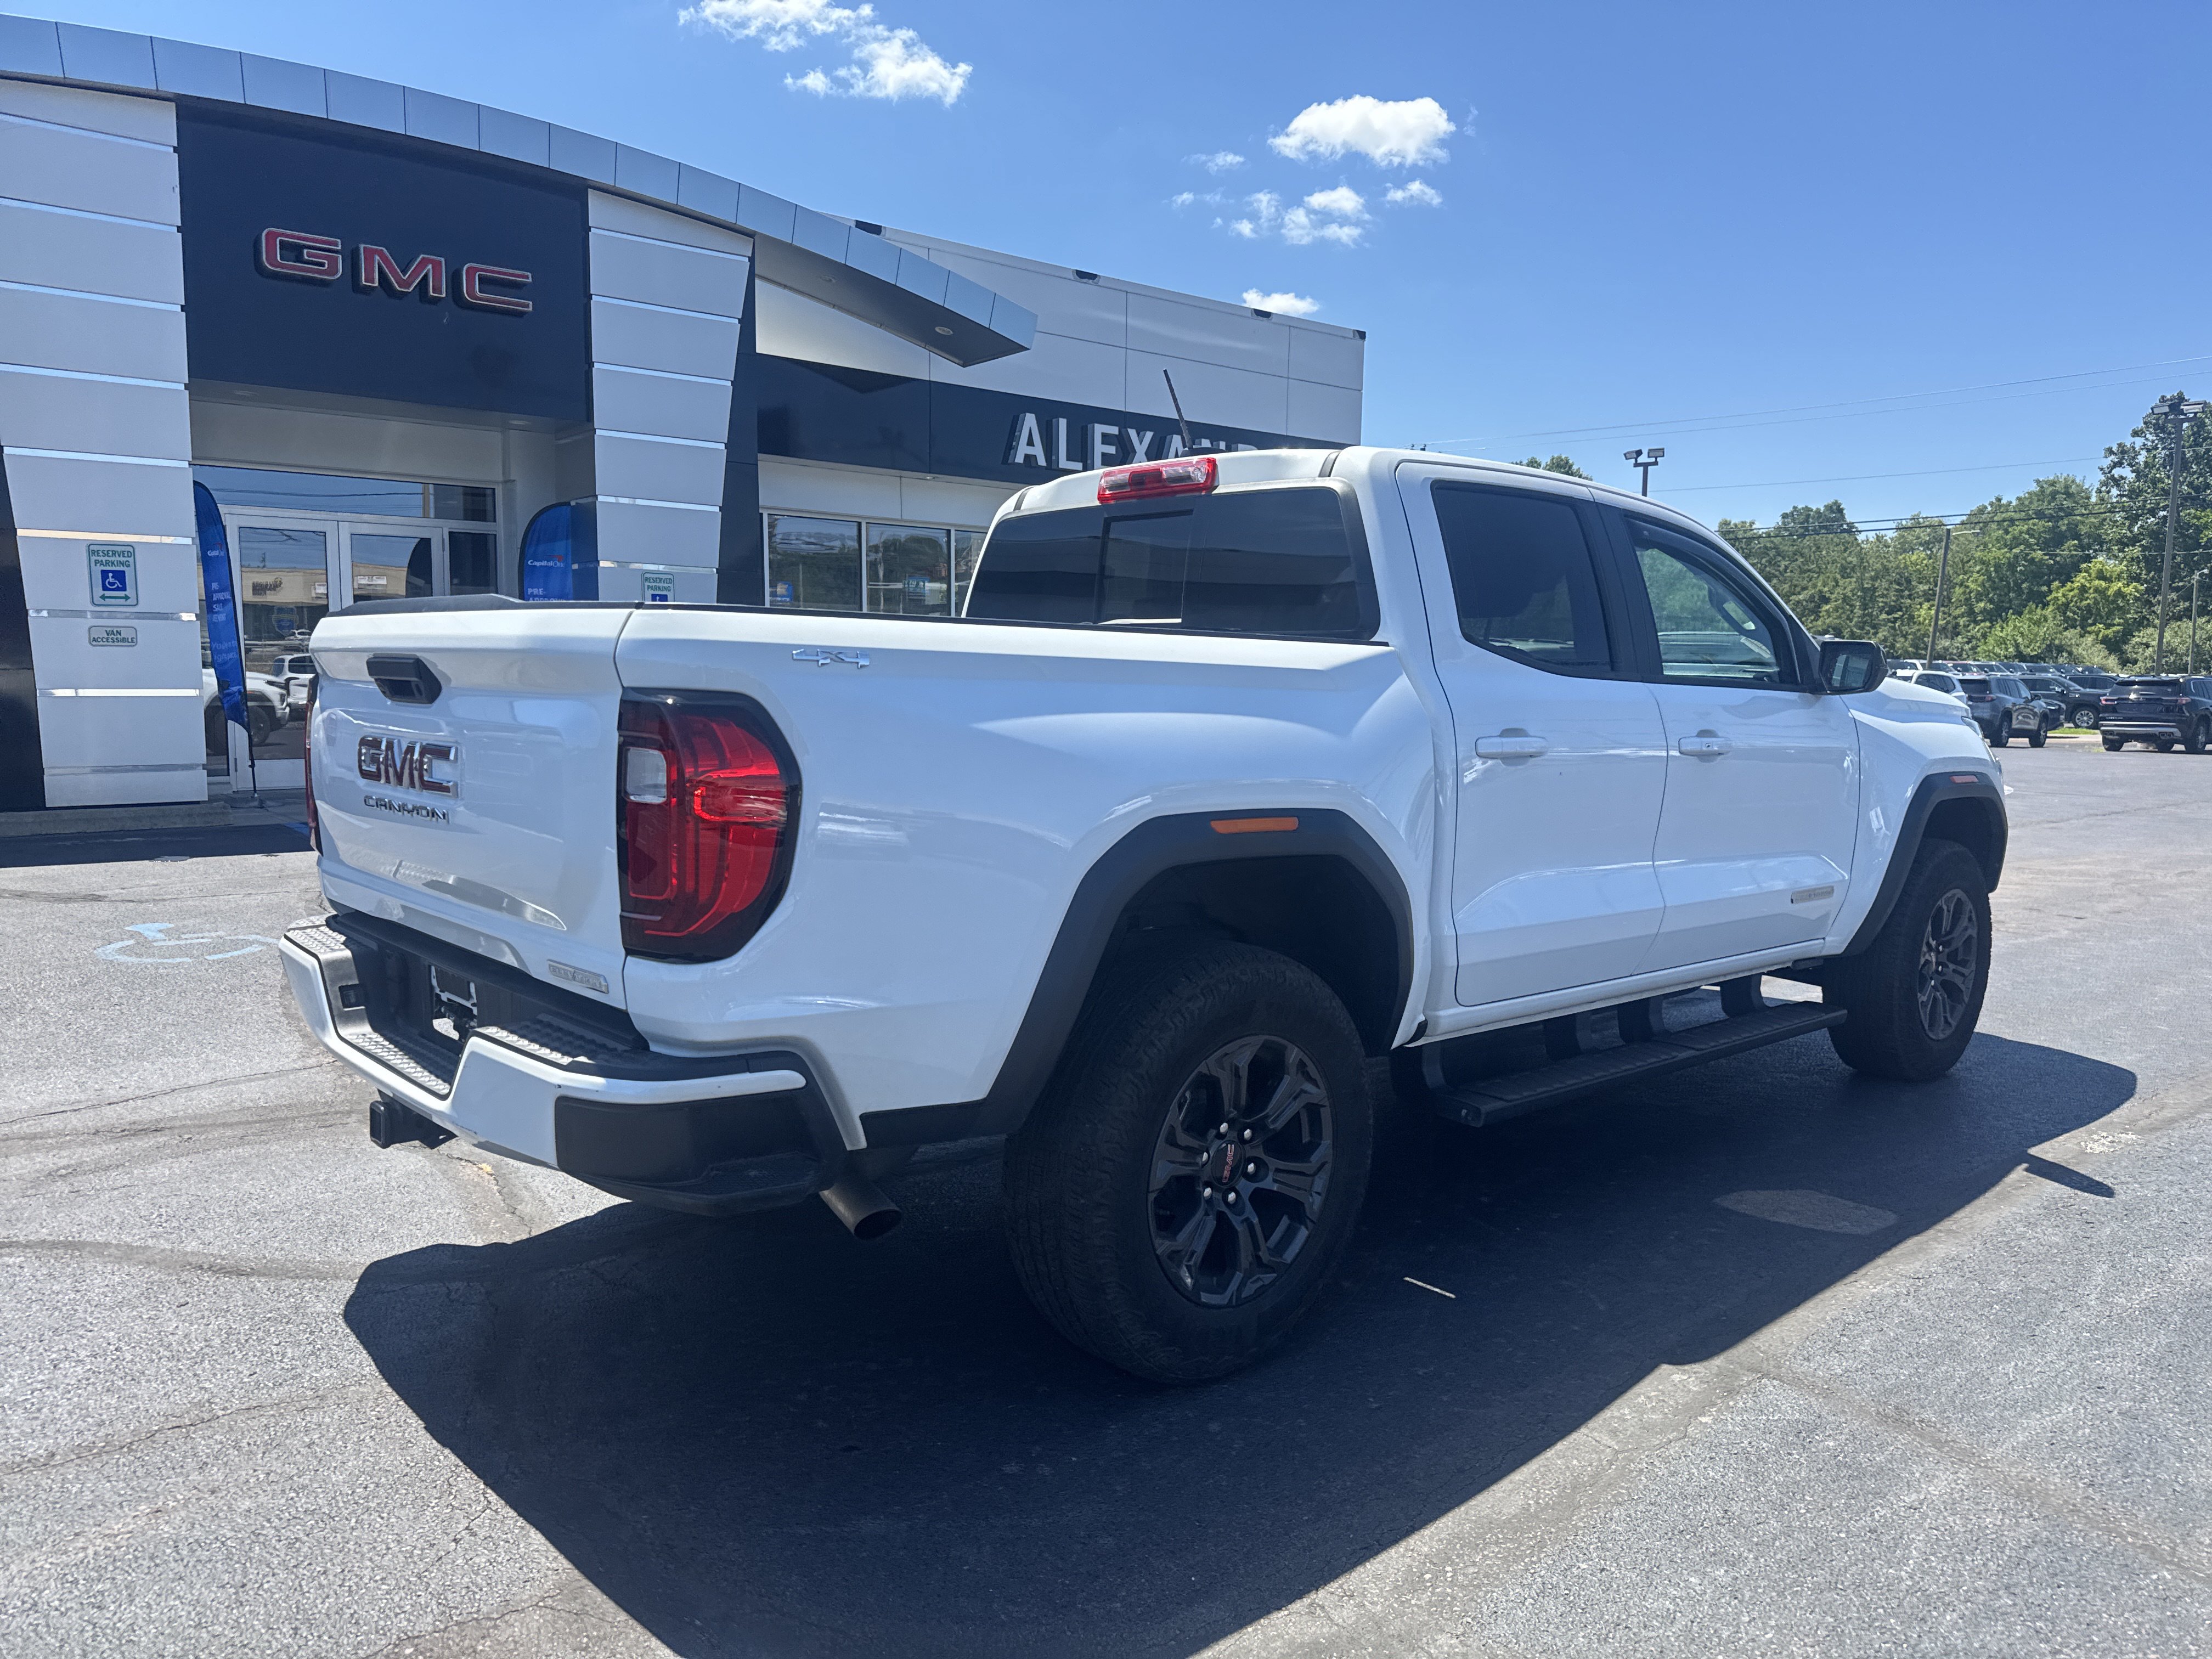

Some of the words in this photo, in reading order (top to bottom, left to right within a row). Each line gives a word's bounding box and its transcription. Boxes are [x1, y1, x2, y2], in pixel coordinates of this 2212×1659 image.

[260, 227, 533, 312] GMC
[1009, 413, 1259, 471] ALEX
[91, 549, 132, 558] RESERVED
[94, 559, 131, 568] PARKING
[358, 735, 458, 799] GMC
[364, 795, 449, 823] CANYON
[1222, 1144, 1234, 1183] GMC
